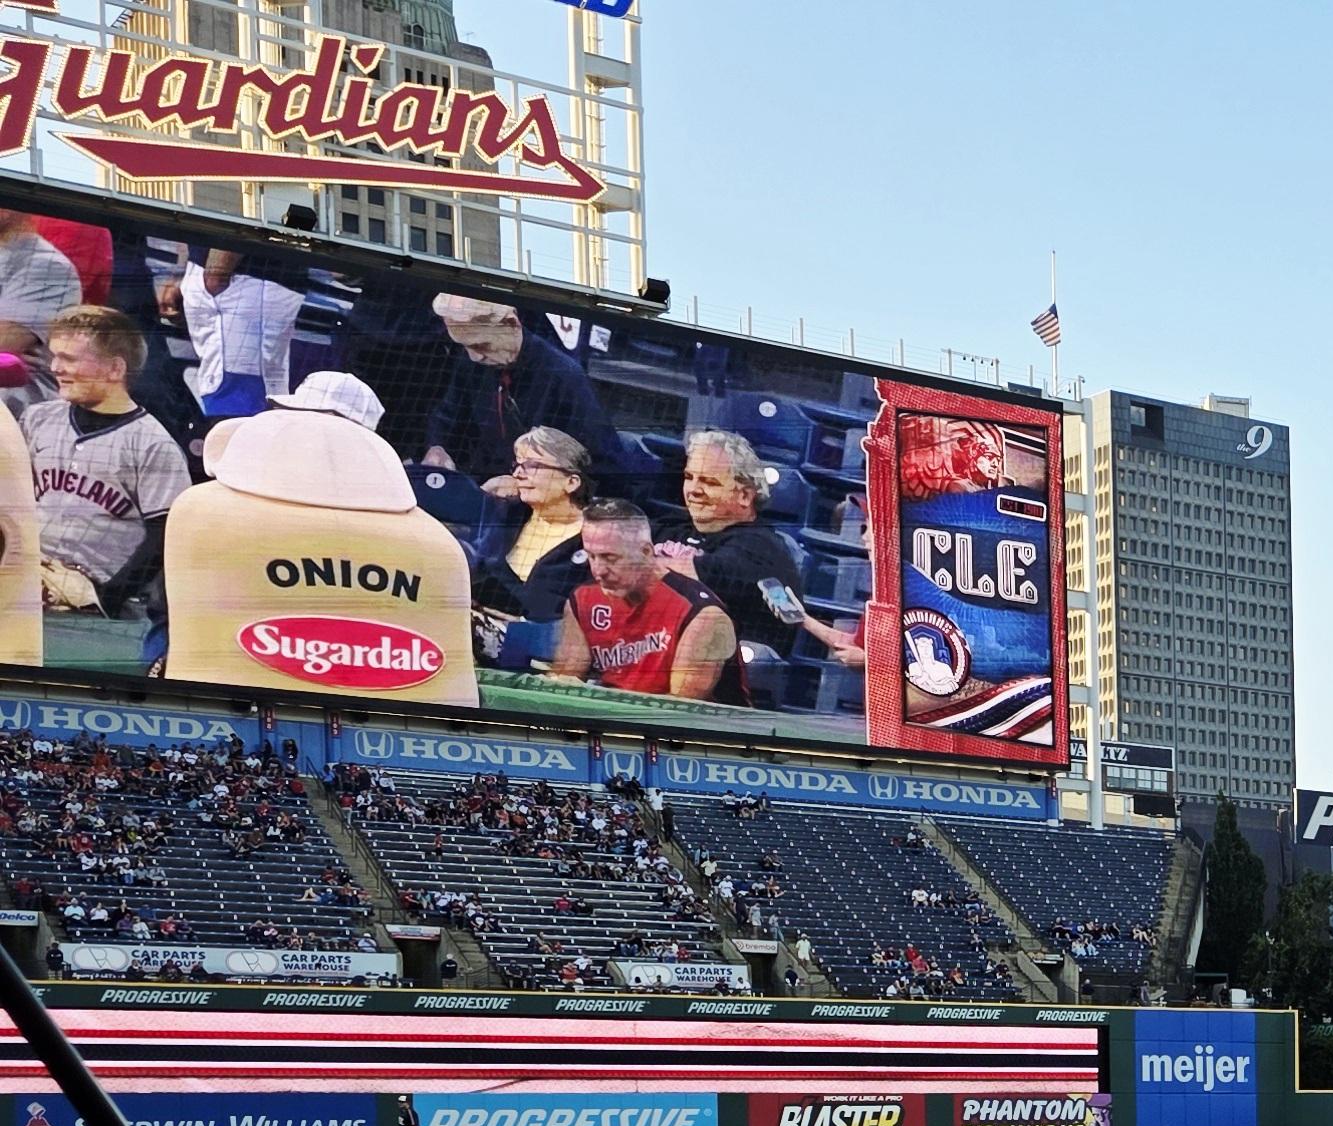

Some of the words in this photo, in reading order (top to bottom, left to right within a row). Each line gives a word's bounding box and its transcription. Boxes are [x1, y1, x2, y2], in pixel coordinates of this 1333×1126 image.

[1244, 425, 1272, 459] 9
[912, 527, 1039, 605] CLE
[266, 558, 421, 602] ONION
[591, 604, 612, 631] C
[252, 623, 440, 675] Sugardale
[38, 706, 238, 742] HONDA
[400, 735, 576, 771] HONDA
[705, 763, 858, 794] HONDA
[903, 781, 1041, 809] HONDA
[131, 950, 159, 959] CAR
[163, 950, 206, 960] PARTS
[281, 953, 308, 963] CAR
[311, 954, 352, 964] PARTS
[675, 967, 697, 975] CAR
[700, 967, 733, 976] PARTS
[101, 989, 213, 1005] PROGRESSIVE
[263, 992, 368, 1008] PROGRESSIVE
[415, 996, 510, 1011] PROGRESSIVE
[555, 999, 646, 1013] PROGRESSIVE
[688, 1001, 773, 1016] PROGRESSIVE
[811, 1004, 891, 1018] PROGRESSIVE
[927, 1007, 1002, 1021] PROGRESSIVE
[1035, 1010, 1107, 1022] PROGRESSIVE
[1141, 1045, 1250, 1091] meijer
[962, 1099, 1085, 1121] PHANTOM
